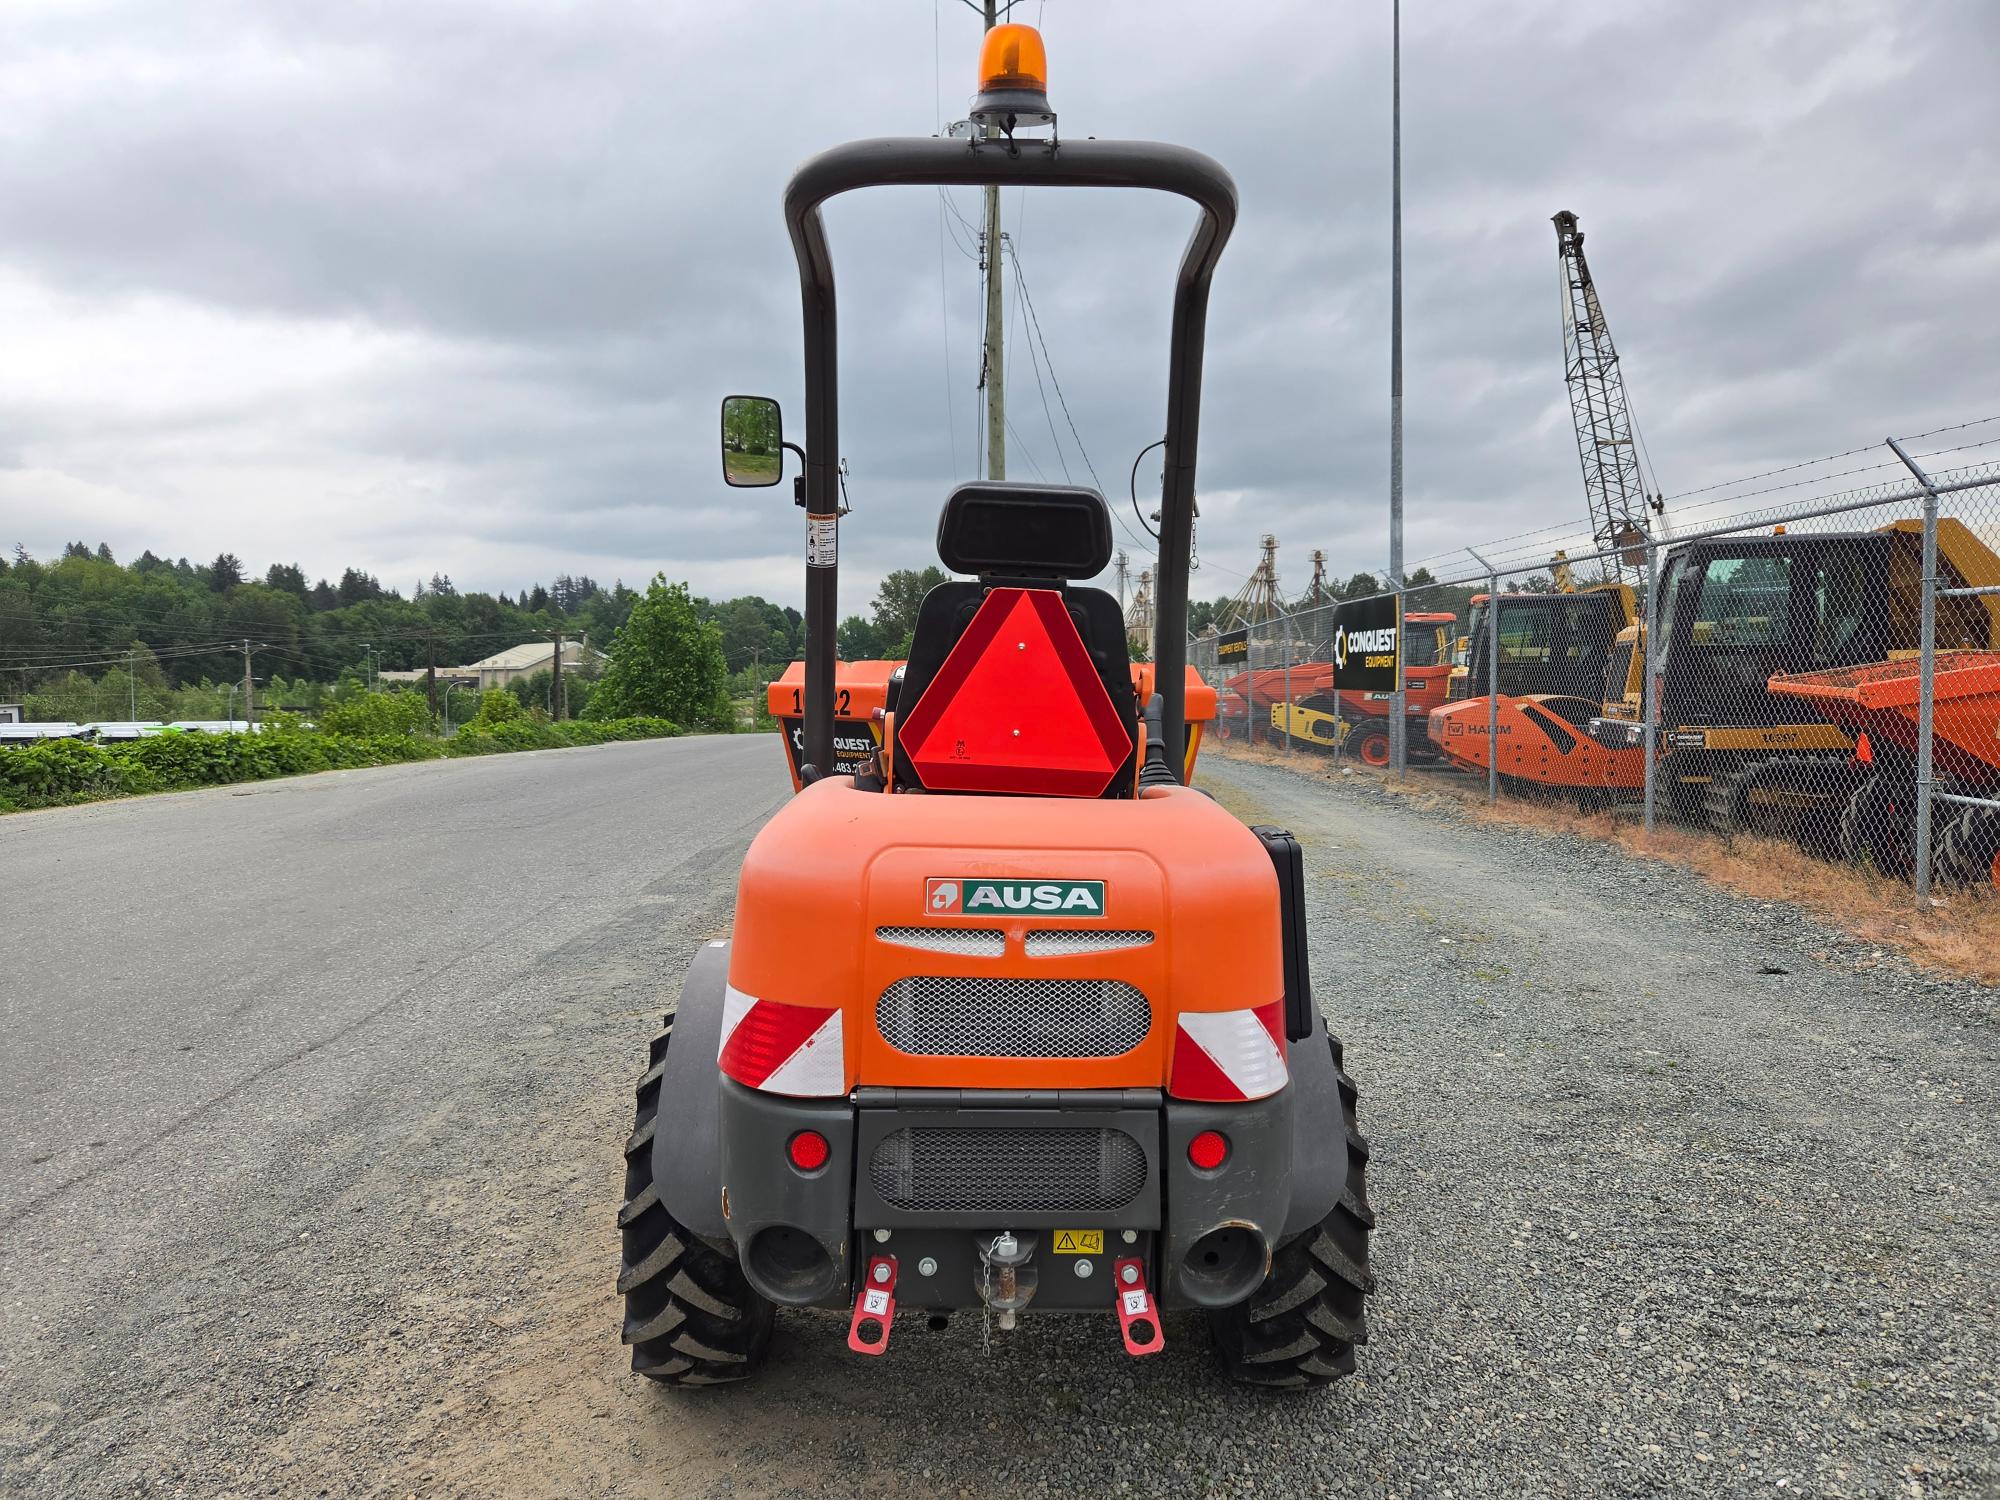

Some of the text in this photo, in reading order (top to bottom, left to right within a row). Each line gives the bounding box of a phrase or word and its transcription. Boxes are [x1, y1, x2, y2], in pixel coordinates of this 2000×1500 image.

[1348, 628, 1396, 653] CONQUEST
[1365, 656, 1394, 668] EQUIPMENT
[836, 750, 871, 759] EQUIPMENT
[966, 885, 1099, 910] AUSA
